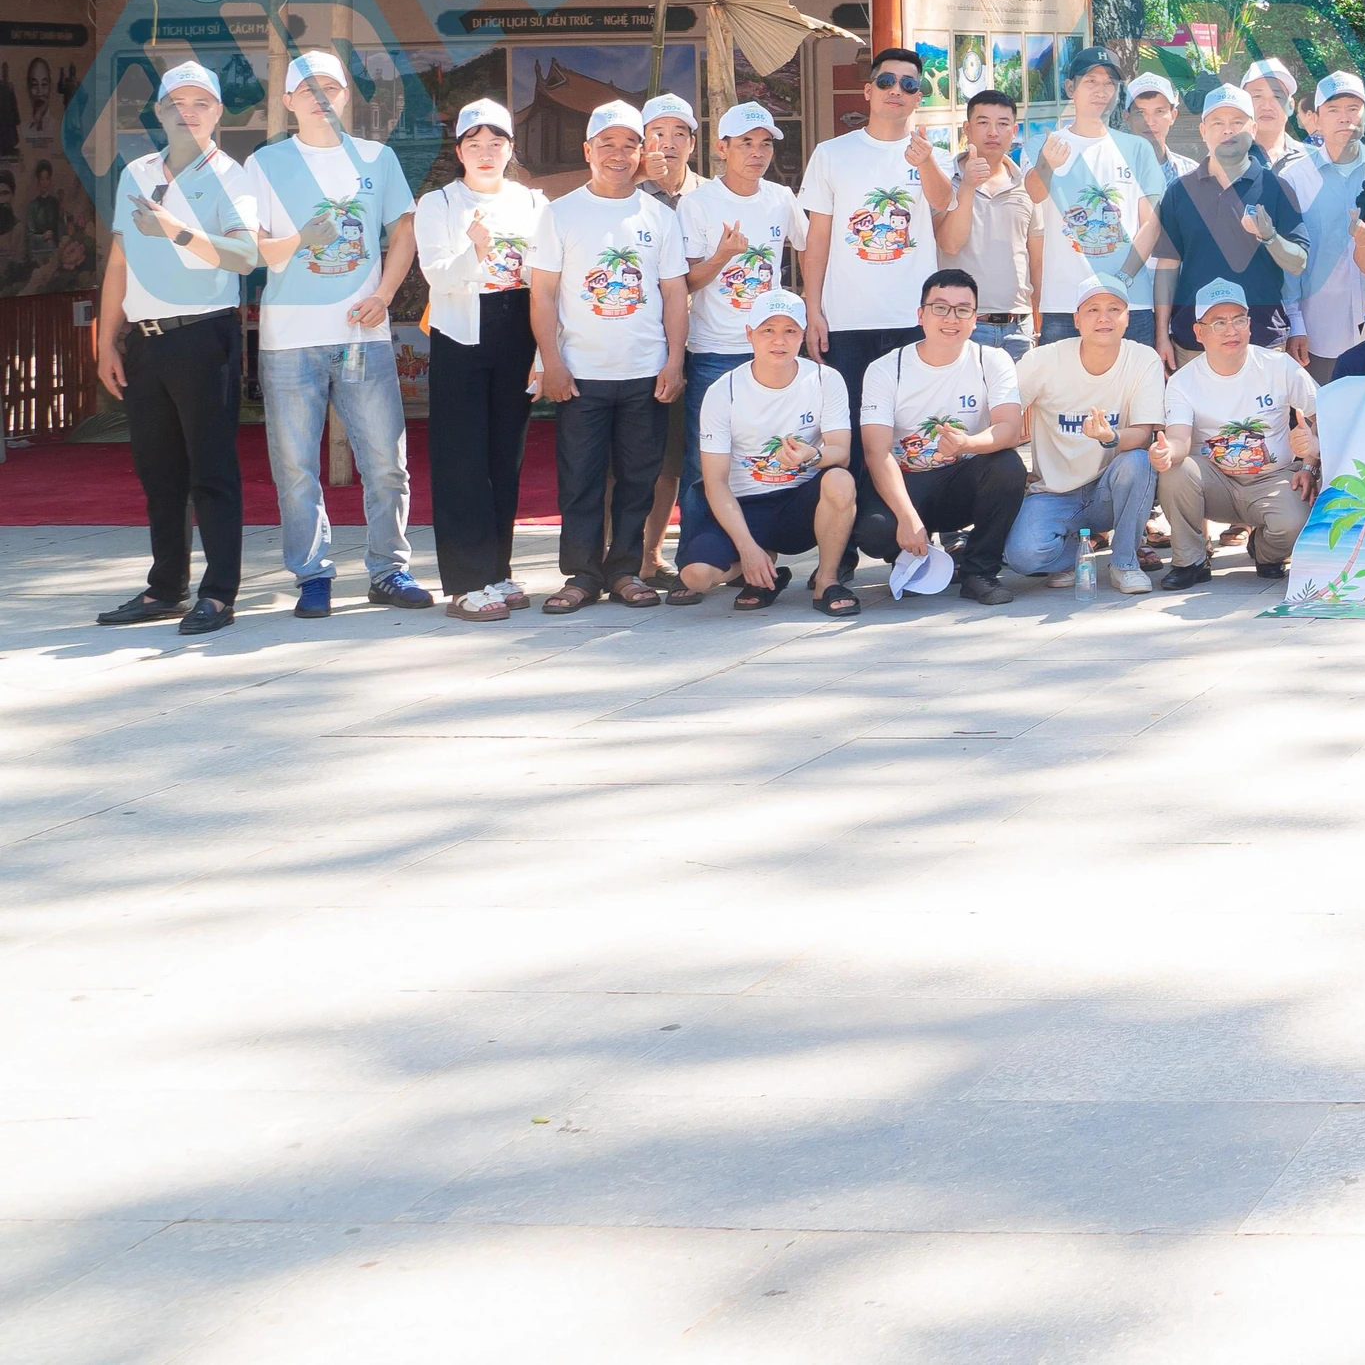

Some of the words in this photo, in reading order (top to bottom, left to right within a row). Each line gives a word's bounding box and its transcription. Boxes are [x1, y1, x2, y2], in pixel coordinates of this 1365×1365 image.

[485, 15, 505, 28] TÍCH
[507, 17, 527, 29] LỊCH
[569, 14, 593, 25] TRÚC
[1117, 167, 1131, 178] 16
[356, 177, 372, 189] 16
[637, 230, 652, 243] 16
[770, 226, 780, 237] 16
[959, 395, 977, 407] 16
[1256, 394, 1273, 407] 16
[800, 412, 814, 424] 16
